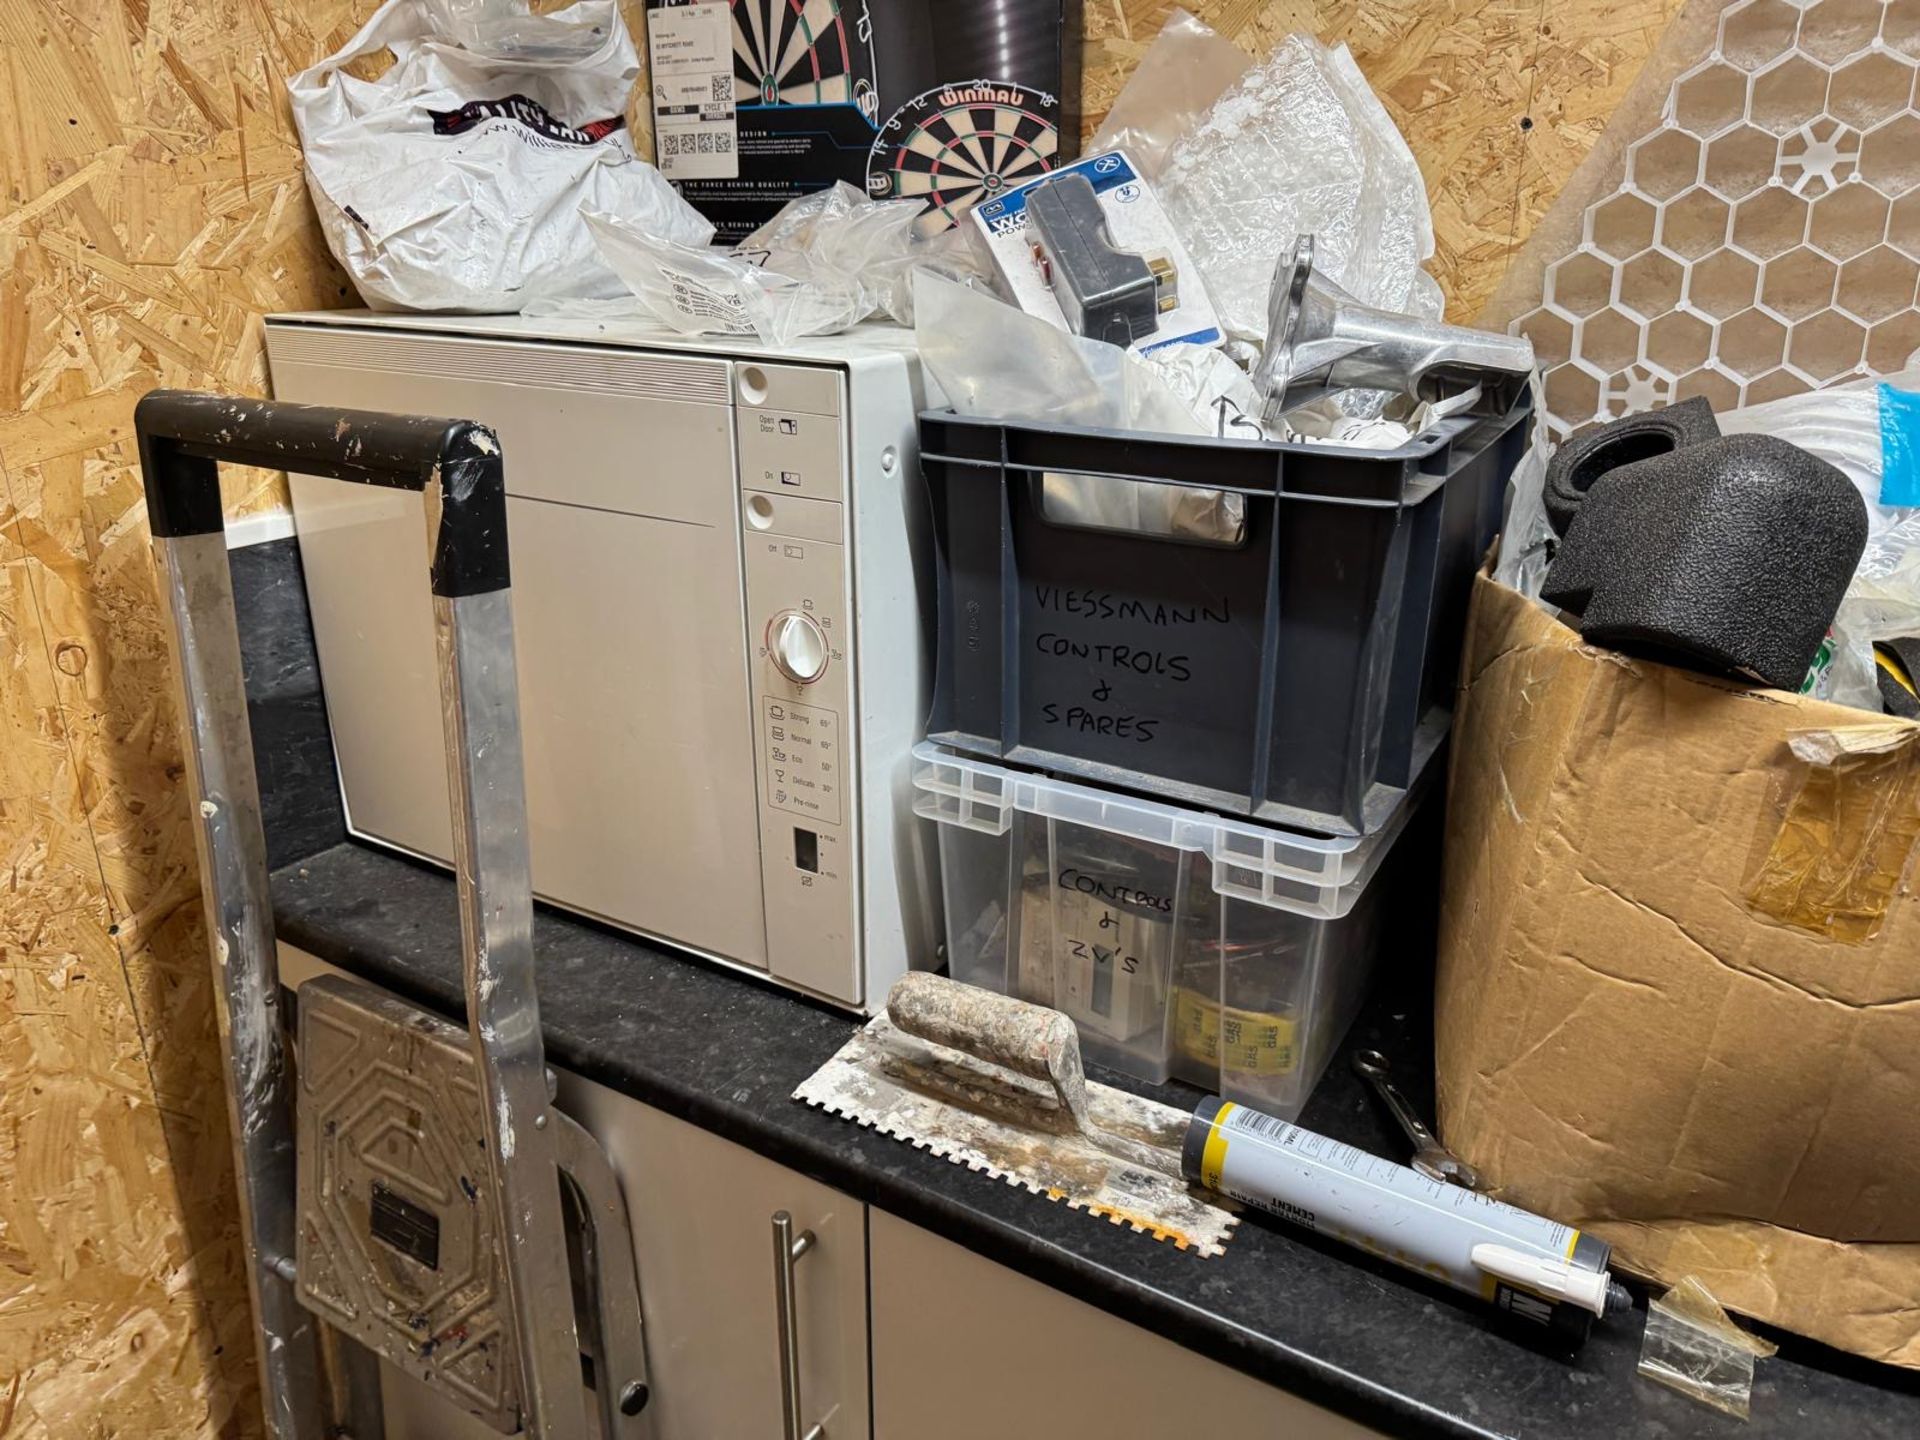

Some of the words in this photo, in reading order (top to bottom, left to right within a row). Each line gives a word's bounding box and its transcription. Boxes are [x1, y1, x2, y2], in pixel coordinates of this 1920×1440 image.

[973, 79, 991, 90] 20
[704, 103, 720, 112] CYCLE
[759, 415, 774, 425] Open
[760, 425, 774, 433] Door
[765, 471, 774, 480] On
[768, 544, 777, 553] Off
[1036, 585, 1230, 625] VIESSMANN
[1036, 632, 1191, 681] CONTROLS
[1043, 704, 1159, 742] SPARES
[791, 734, 811, 745] Normal
[792, 776, 815, 788] Delicate
[793, 796, 819, 810] Pre-rinse
[1271, 1197, 1316, 1222] CEMENT
